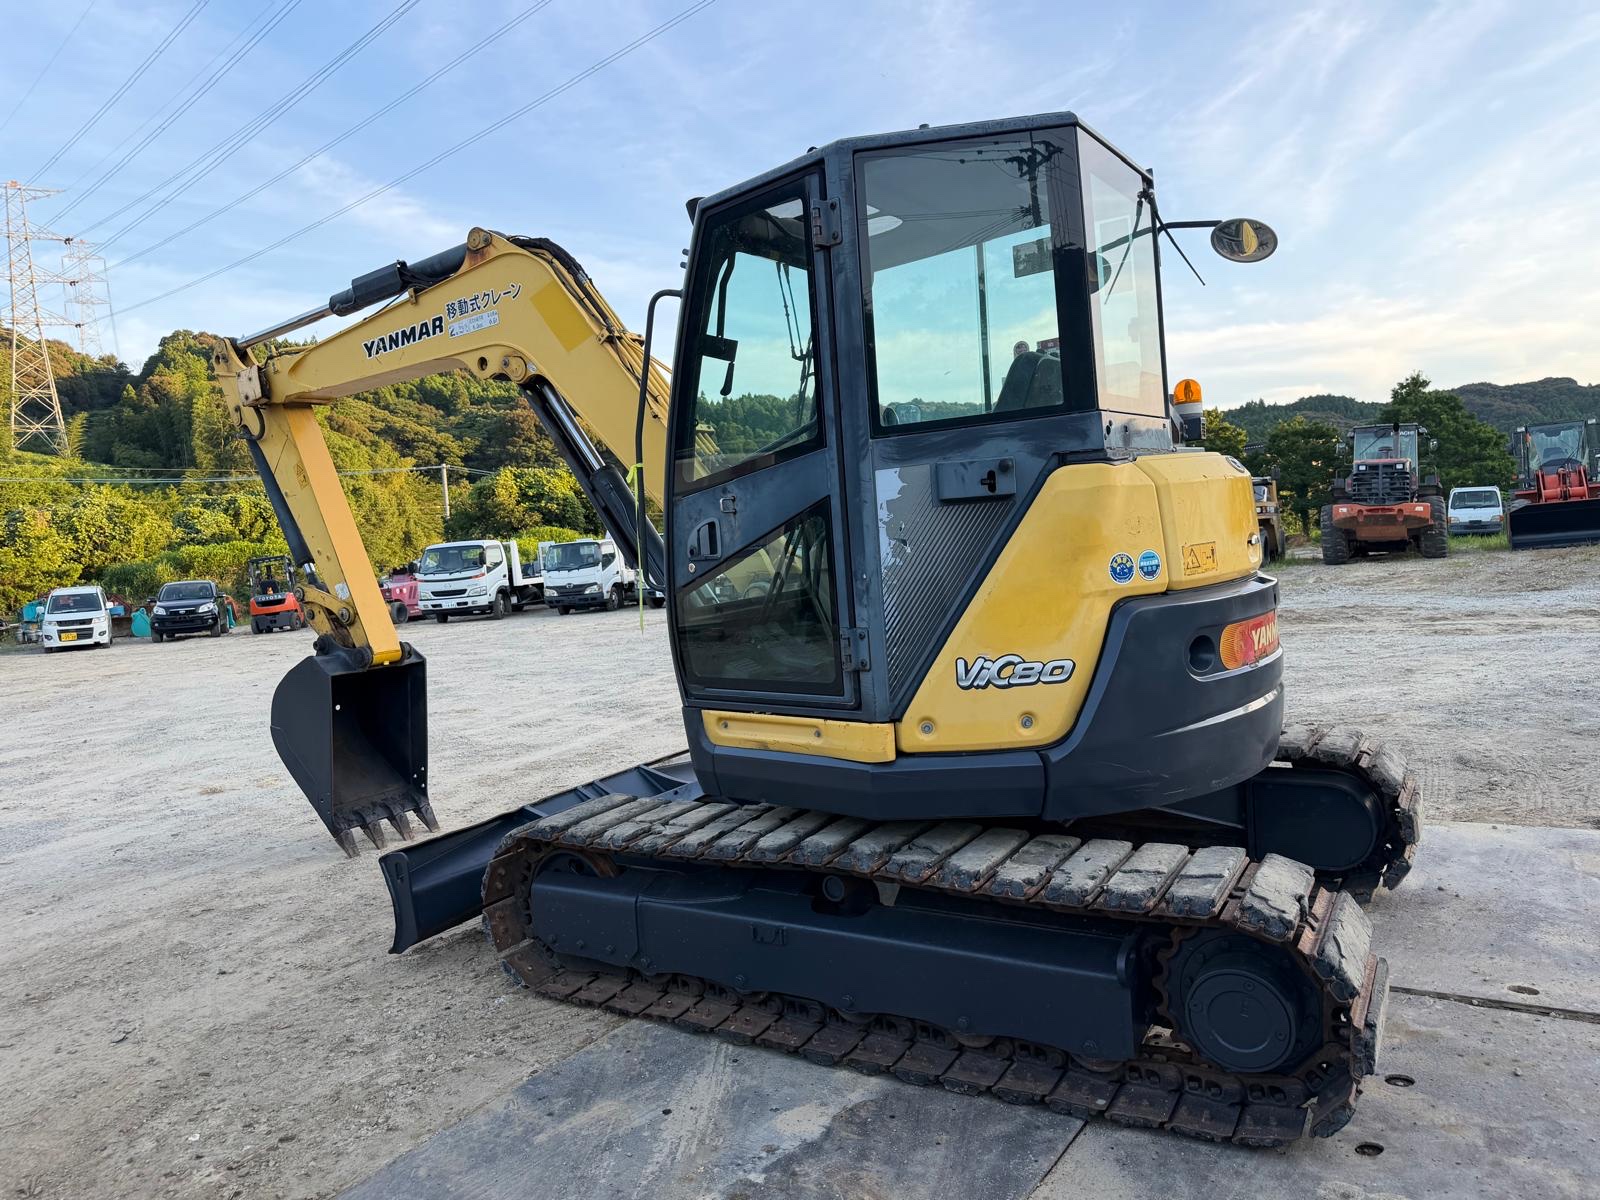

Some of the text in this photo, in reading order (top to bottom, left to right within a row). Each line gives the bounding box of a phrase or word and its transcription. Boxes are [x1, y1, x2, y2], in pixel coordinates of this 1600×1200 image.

[446, 284, 521, 319] 移動式クレーン
[363, 315, 444, 358] YANMAR
